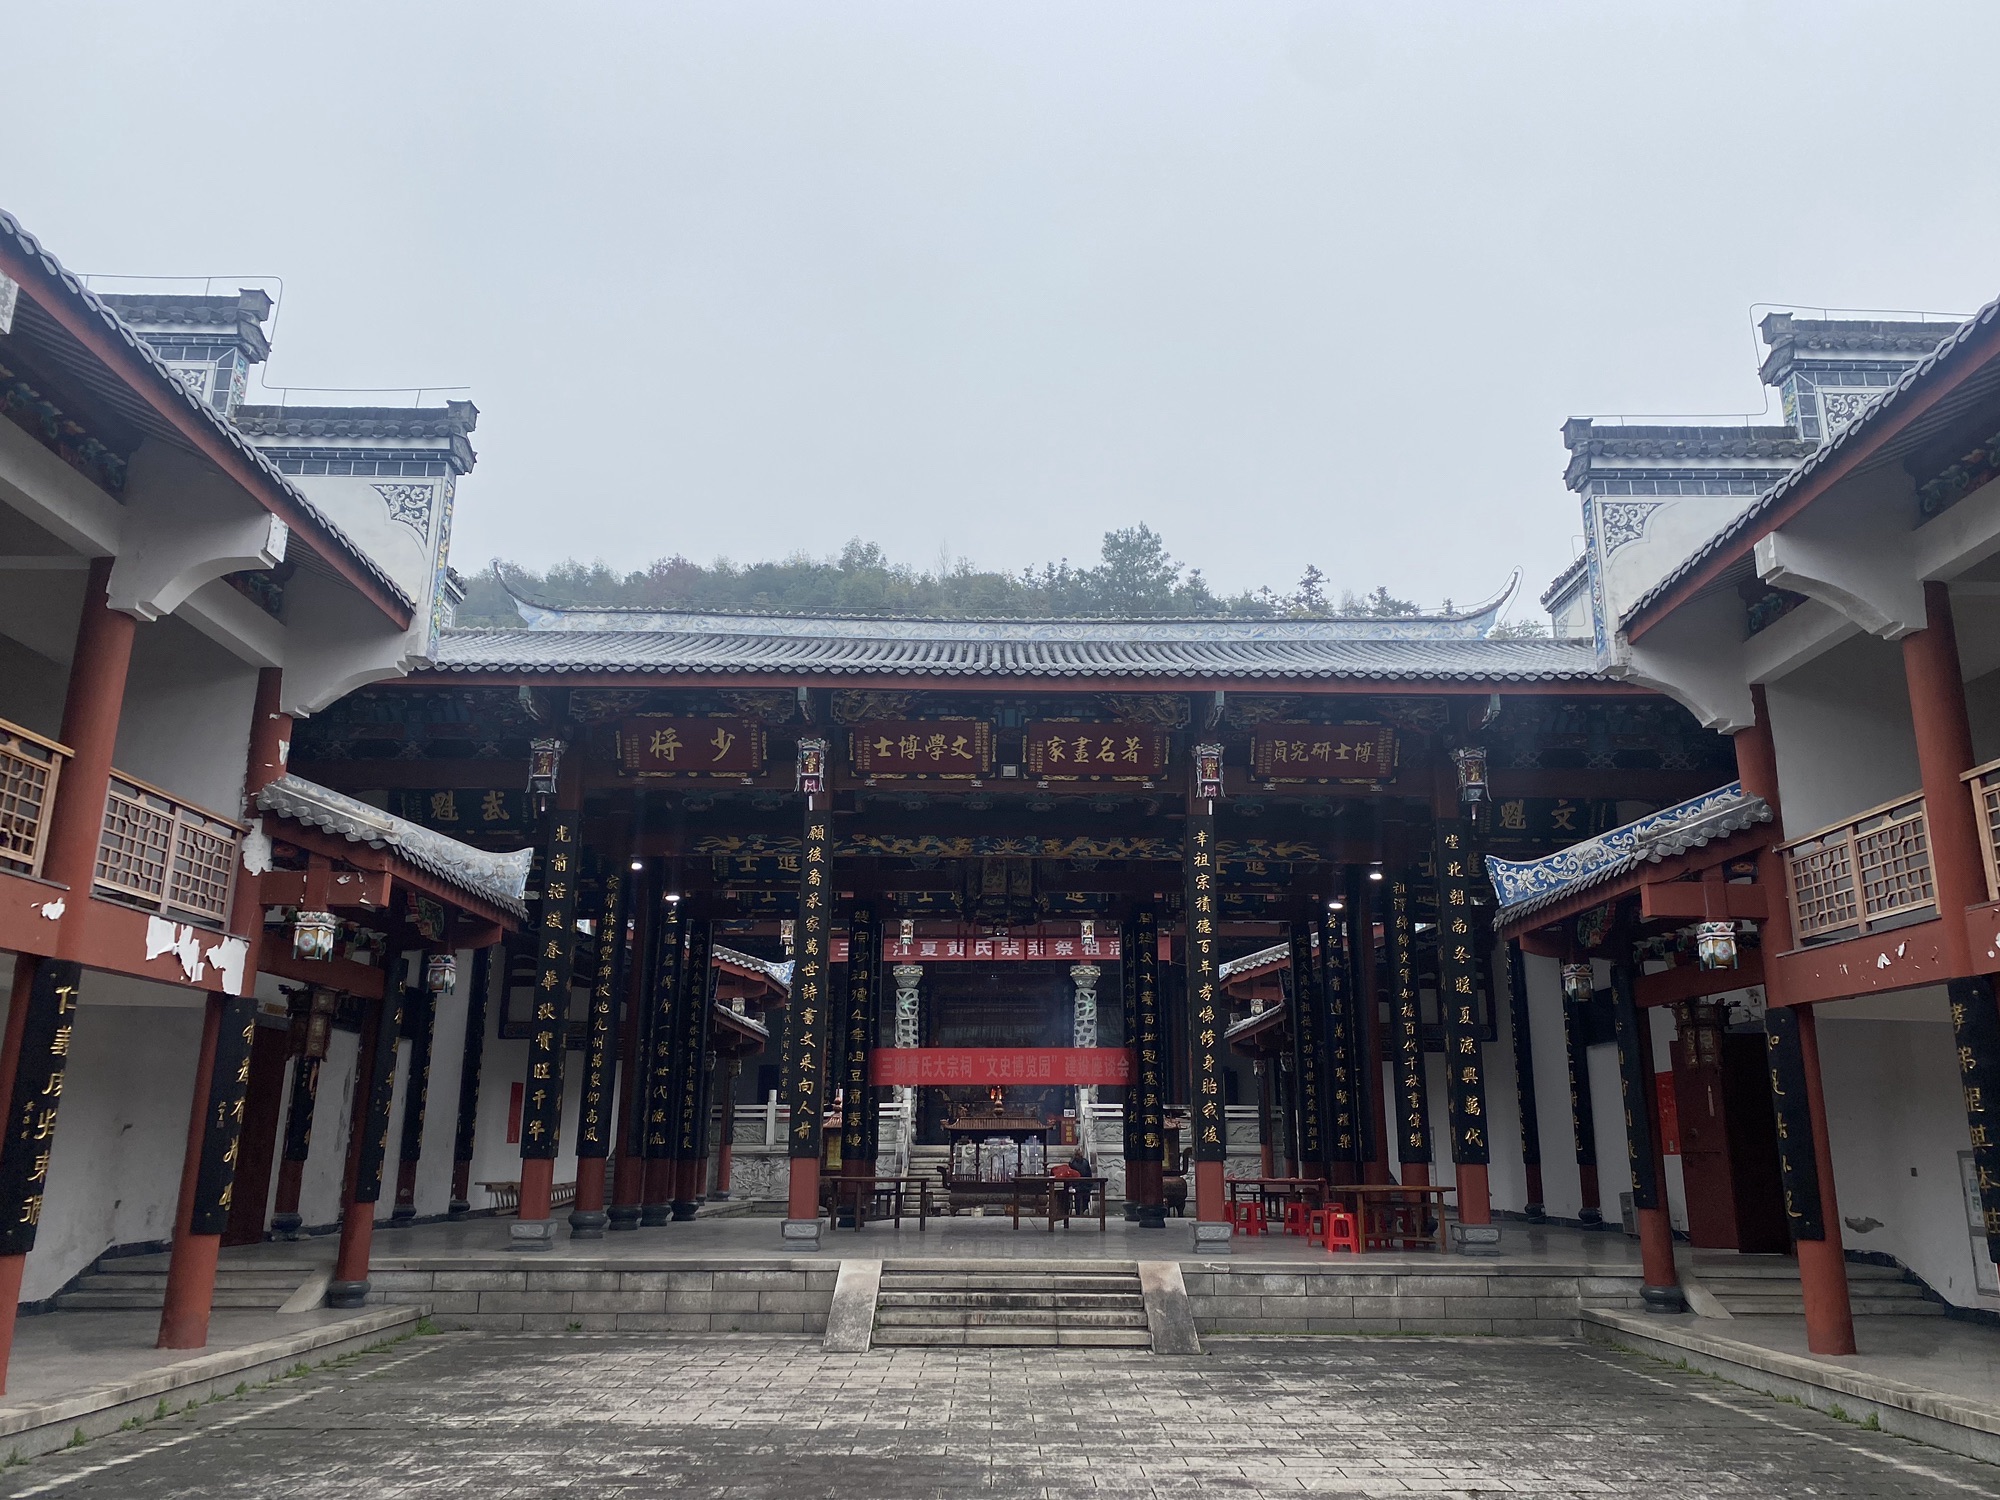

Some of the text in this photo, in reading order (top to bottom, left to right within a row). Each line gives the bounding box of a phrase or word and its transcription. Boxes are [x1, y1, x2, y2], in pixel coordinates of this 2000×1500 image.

[872, 733, 973, 760] 文學博士
[1046, 735, 1144, 763] 著名畫家
[430, 790, 510, 821] 武魁
[1499, 799, 1577, 831] 文魁
